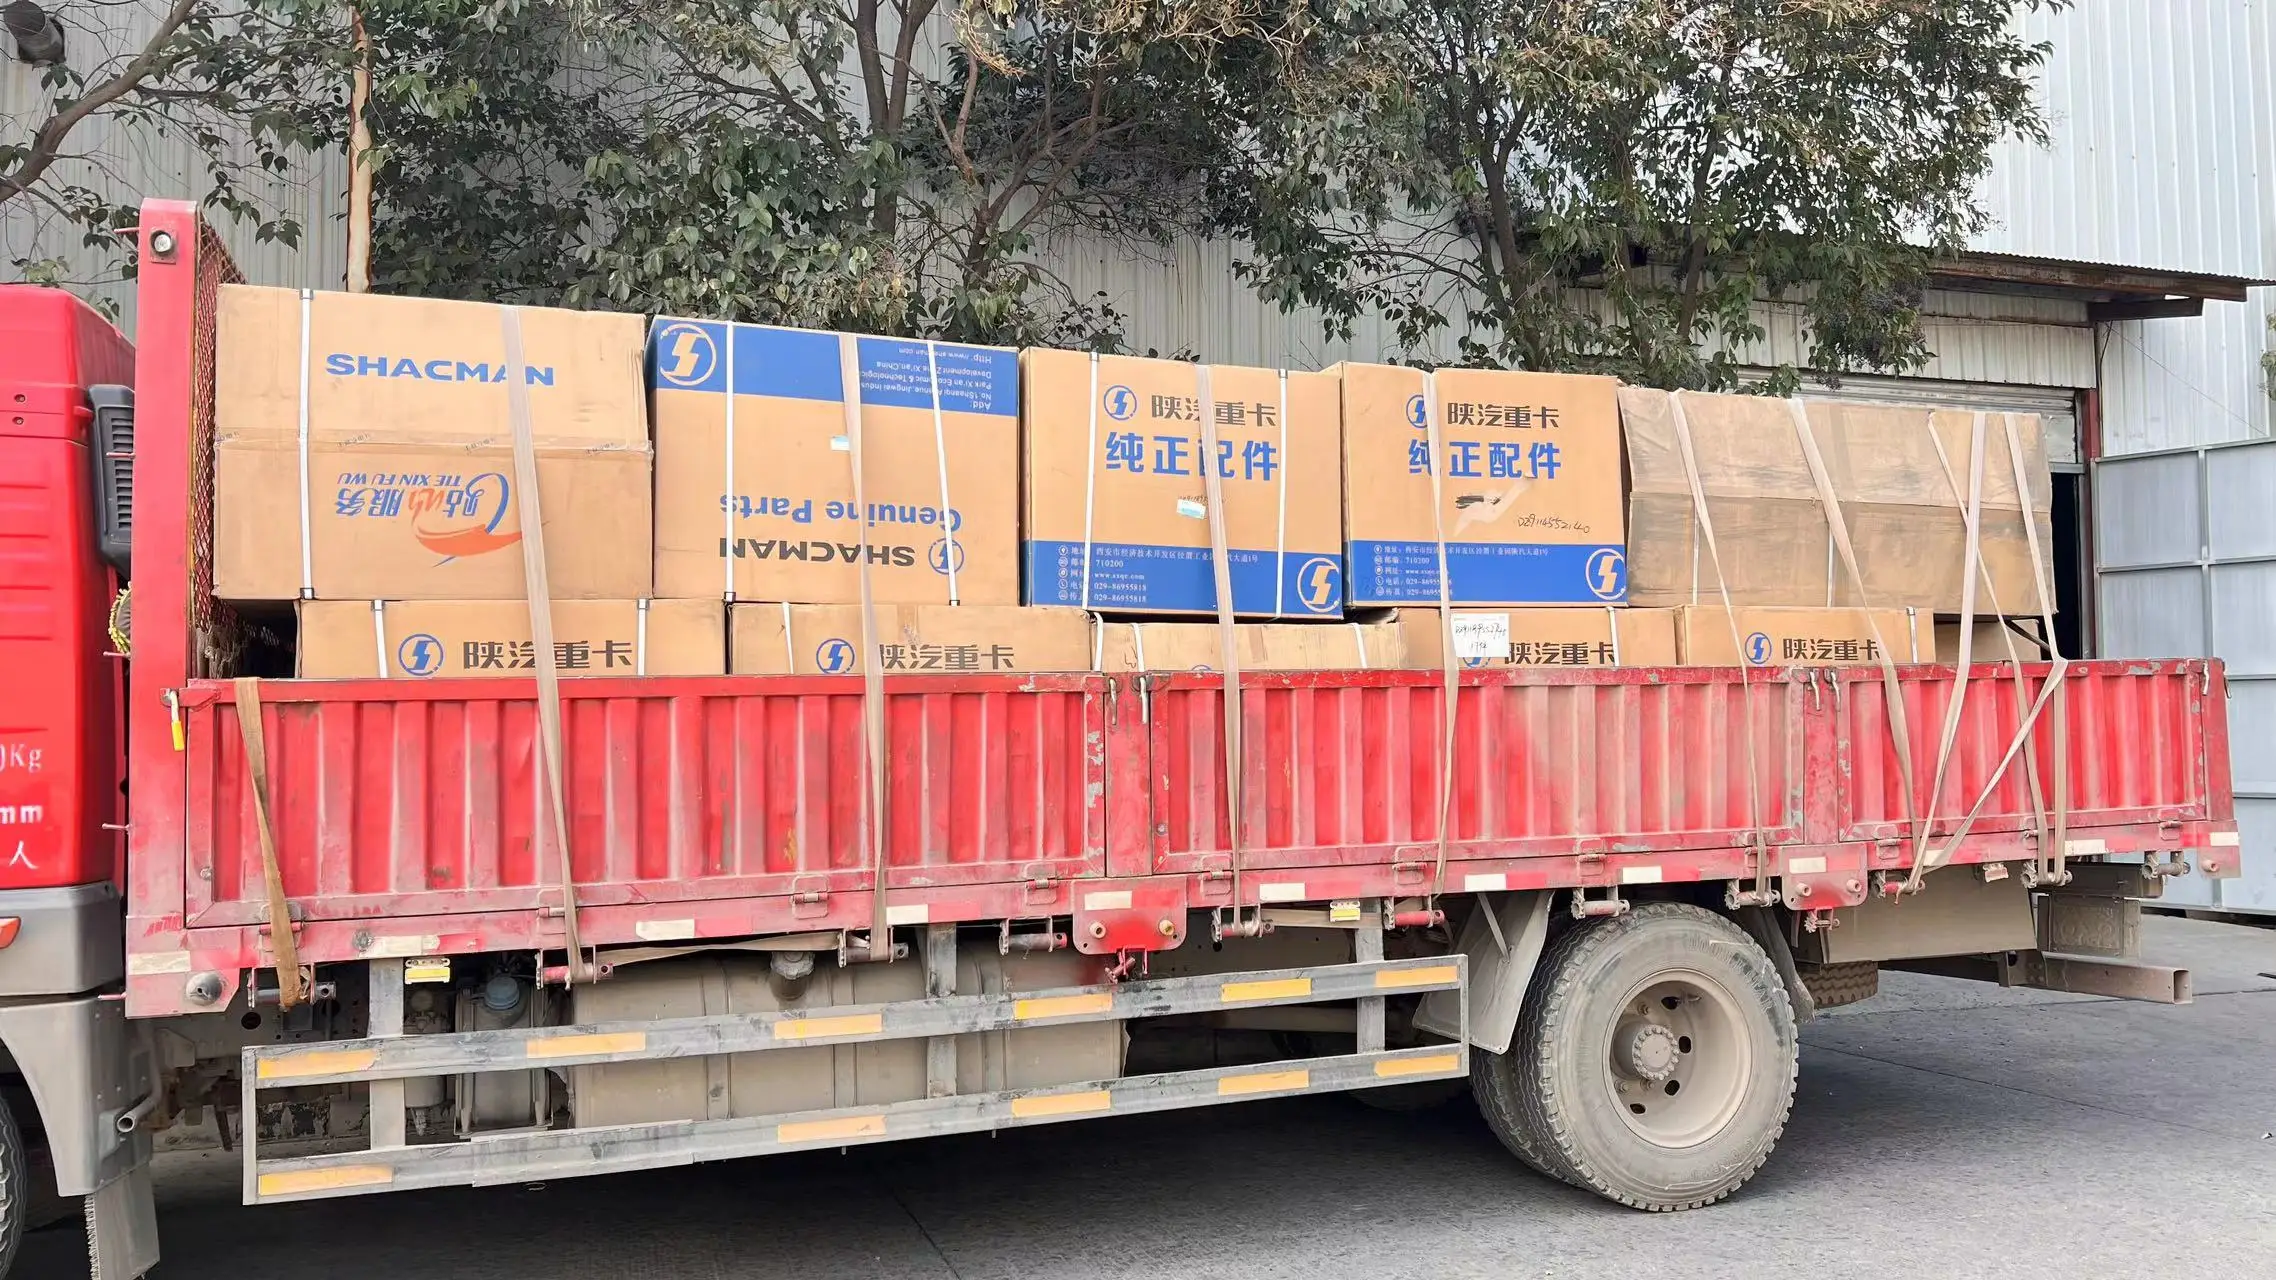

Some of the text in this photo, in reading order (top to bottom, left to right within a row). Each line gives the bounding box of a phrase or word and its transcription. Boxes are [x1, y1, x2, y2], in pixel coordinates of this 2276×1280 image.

[908, 375, 914, 383] &
[916, 376, 952, 386] Ecomic
[943, 366, 992, 379] Development
[975, 381, 992, 390] Park
[1448, 402, 1559, 429] 陕汽重卡
[337, 472, 461, 487] TIE XIN FU WU
[335, 487, 482, 519] 贴心服务
[720, 495, 962, 531] Genuine Parts
[720, 538, 916, 566] SHACMAN
[1096, 559, 1124, 567] 710200
[463, 640, 632, 669] 陕汽重卡
[880, 644, 1015, 670] 陕汽重卡
[1504, 642, 1616, 665] 陕汽重卡
[9, 840, 39, 870] 人
